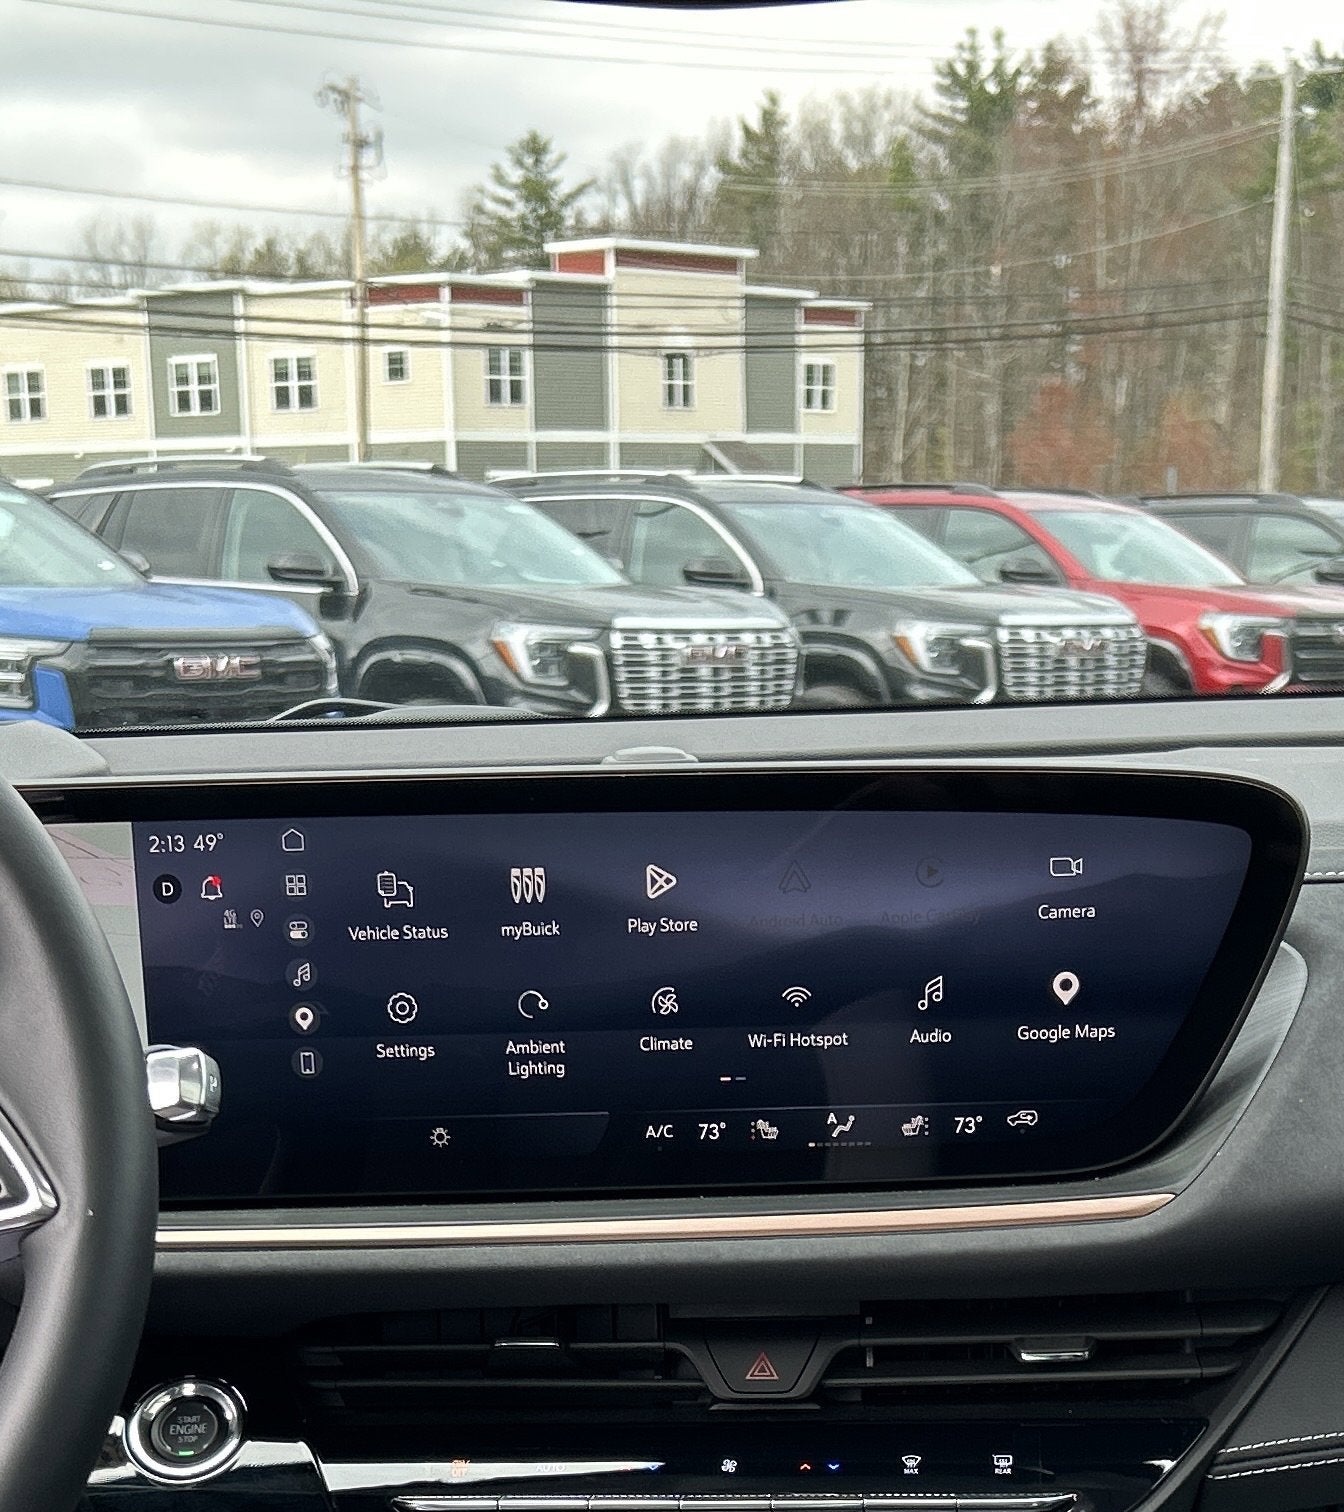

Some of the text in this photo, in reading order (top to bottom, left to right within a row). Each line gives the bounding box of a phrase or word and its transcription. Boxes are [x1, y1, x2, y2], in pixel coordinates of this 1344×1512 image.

[148, 835, 185, 853] 2:13
[162, 881, 174, 897] D
[1038, 904, 1096, 920] Camera
[348, 924, 449, 942] Vehicle Status
[501, 919, 561, 941] myBuick
[627, 917, 698, 937] Play Store
[910, 1028, 952, 1044] Audio
[1017, 1023, 1116, 1043] Google Maps
[506, 1039, 566, 1055] Ambient
[639, 1036, 693, 1052] Climate
[748, 1032, 849, 1051] Wi-Fi Hotspot
[376, 1043, 436, 1060] Settings
[508, 1060, 565, 1079] Lighting
[645, 1124, 674, 1139] A/C
[698, 1121, 727, 1140] 73°
[955, 1115, 983, 1134] 73°
[177, 1415, 201, 1424] START
[169, 1423, 208, 1435] ENGINE
[177, 1435, 199, 1444] STOP
[536, 1464, 566, 1472] AUTO
